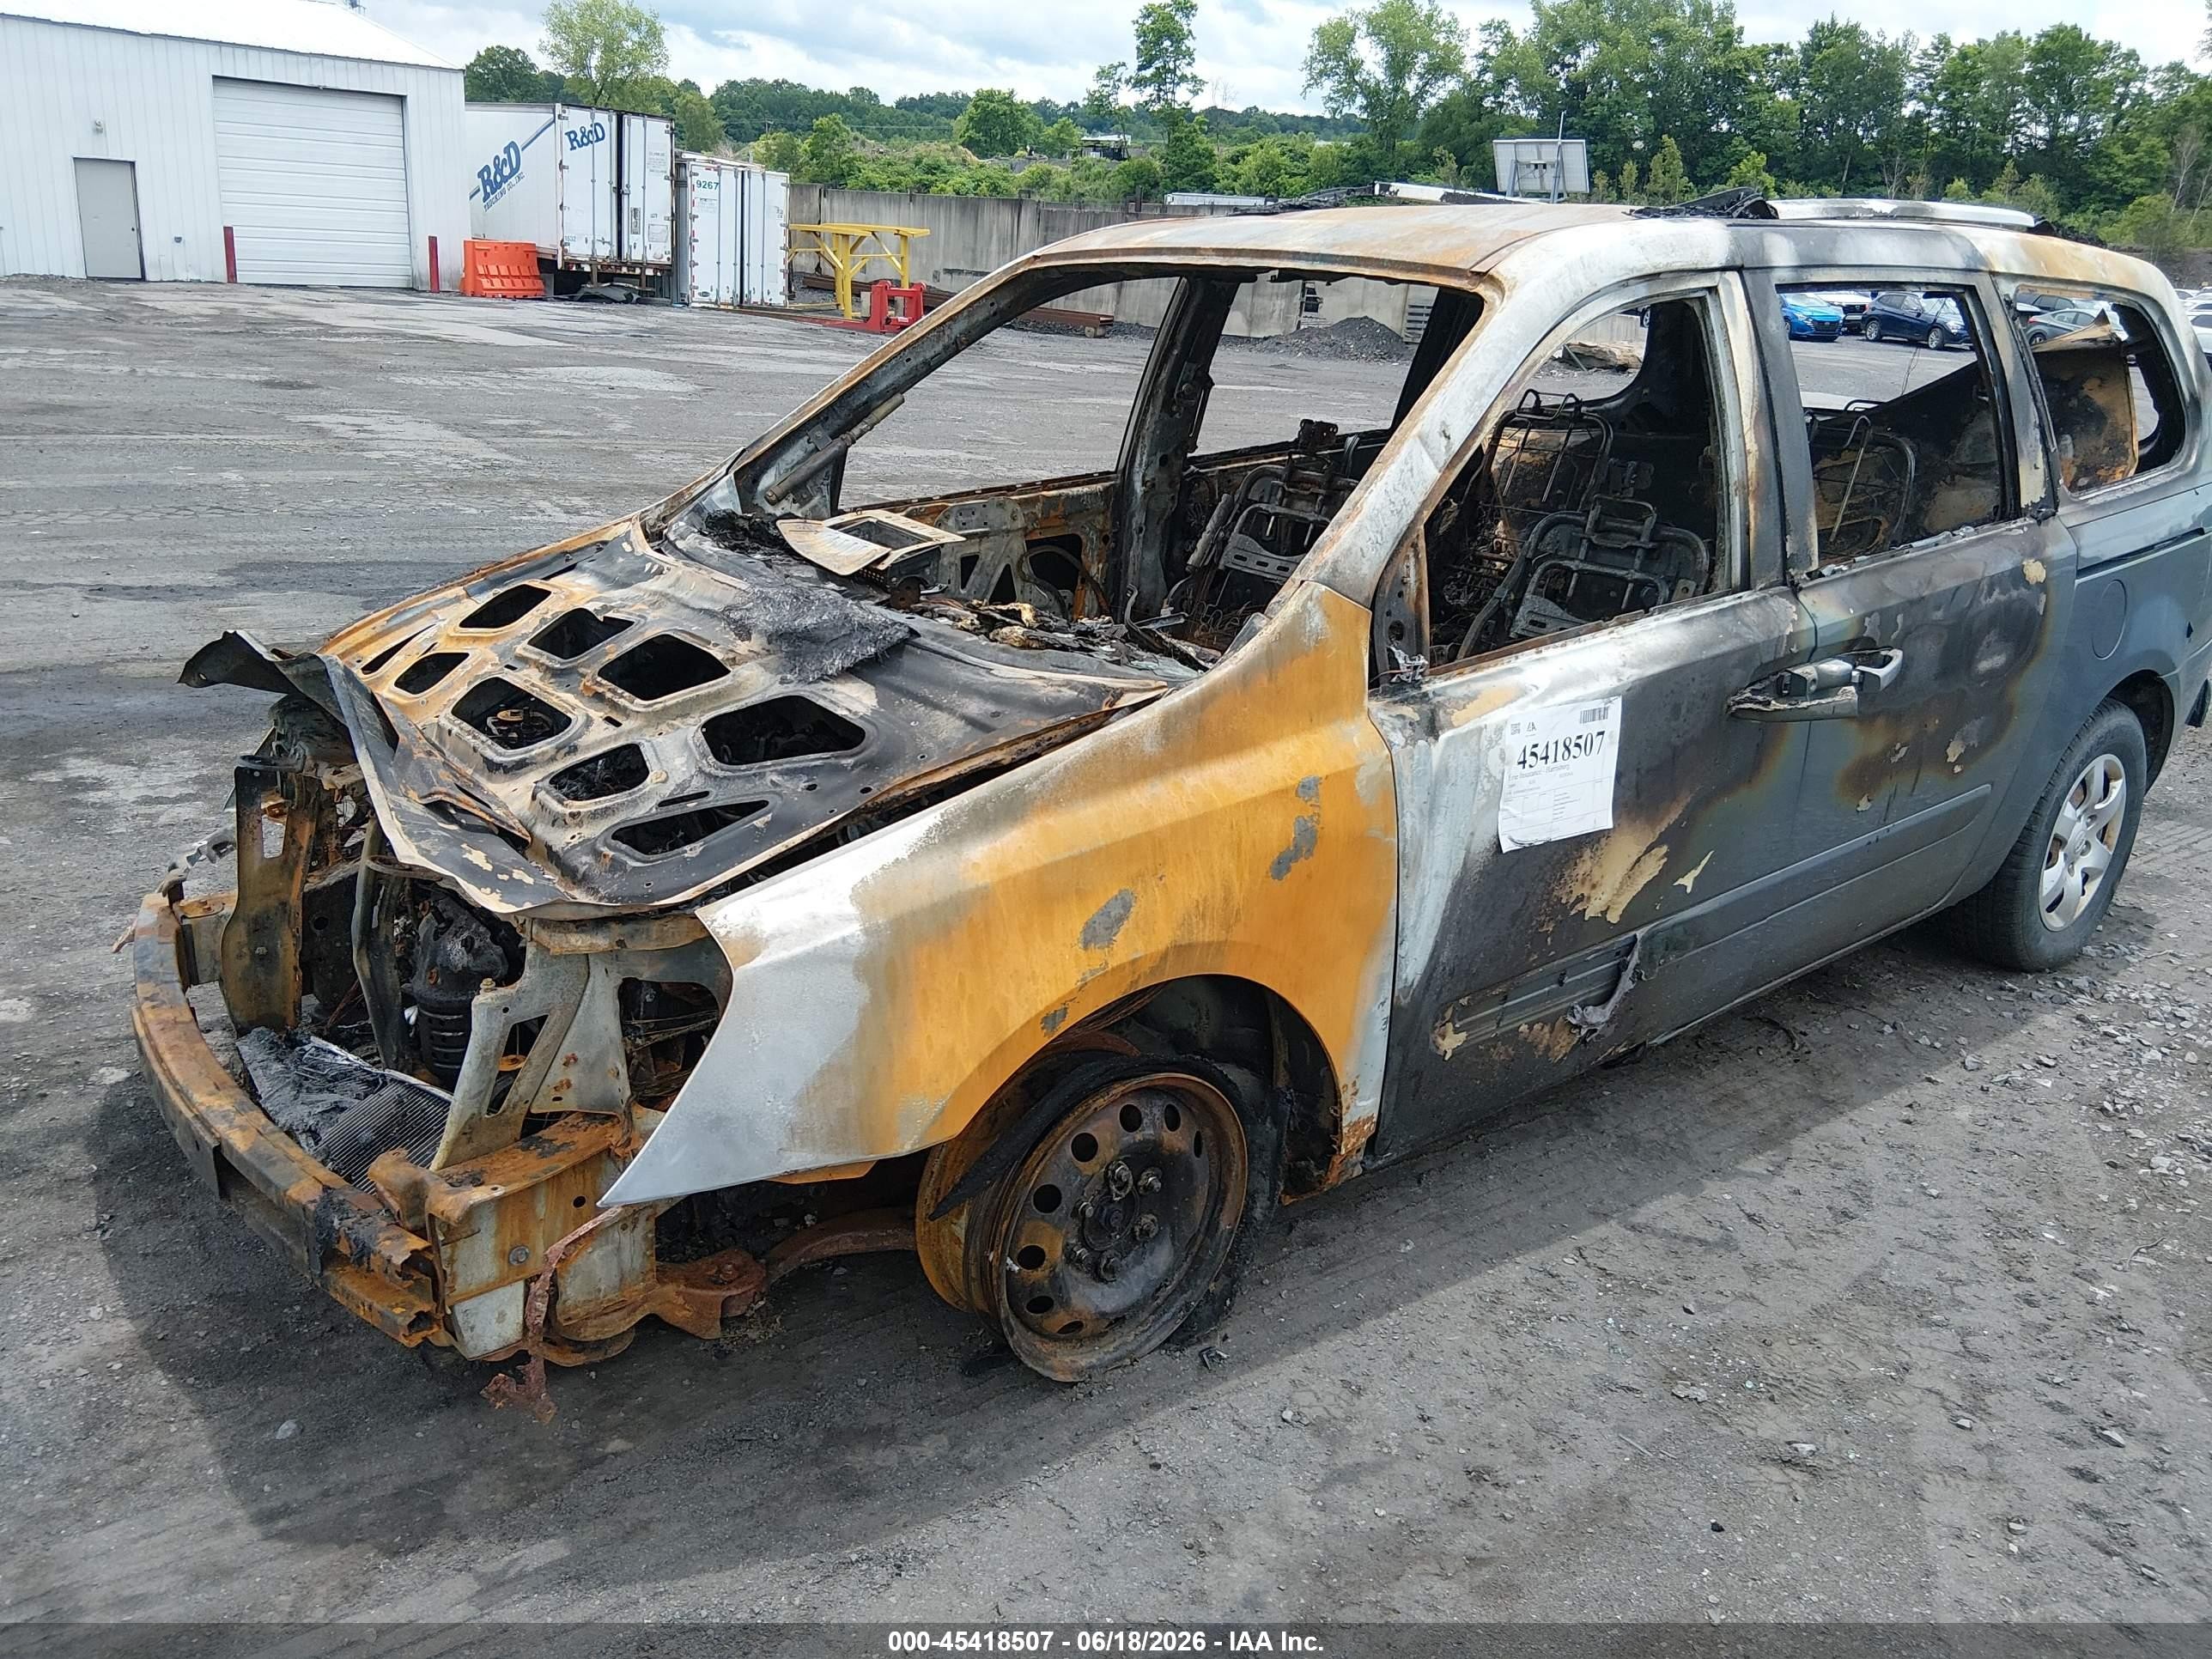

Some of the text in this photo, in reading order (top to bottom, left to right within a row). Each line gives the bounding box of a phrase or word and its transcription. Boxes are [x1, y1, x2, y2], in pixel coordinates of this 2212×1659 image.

[565, 122, 605, 151] R&D
[477, 141, 521, 204] R&D
[696, 179, 720, 191] 9267
[1517, 730, 1606, 769] 45418507
